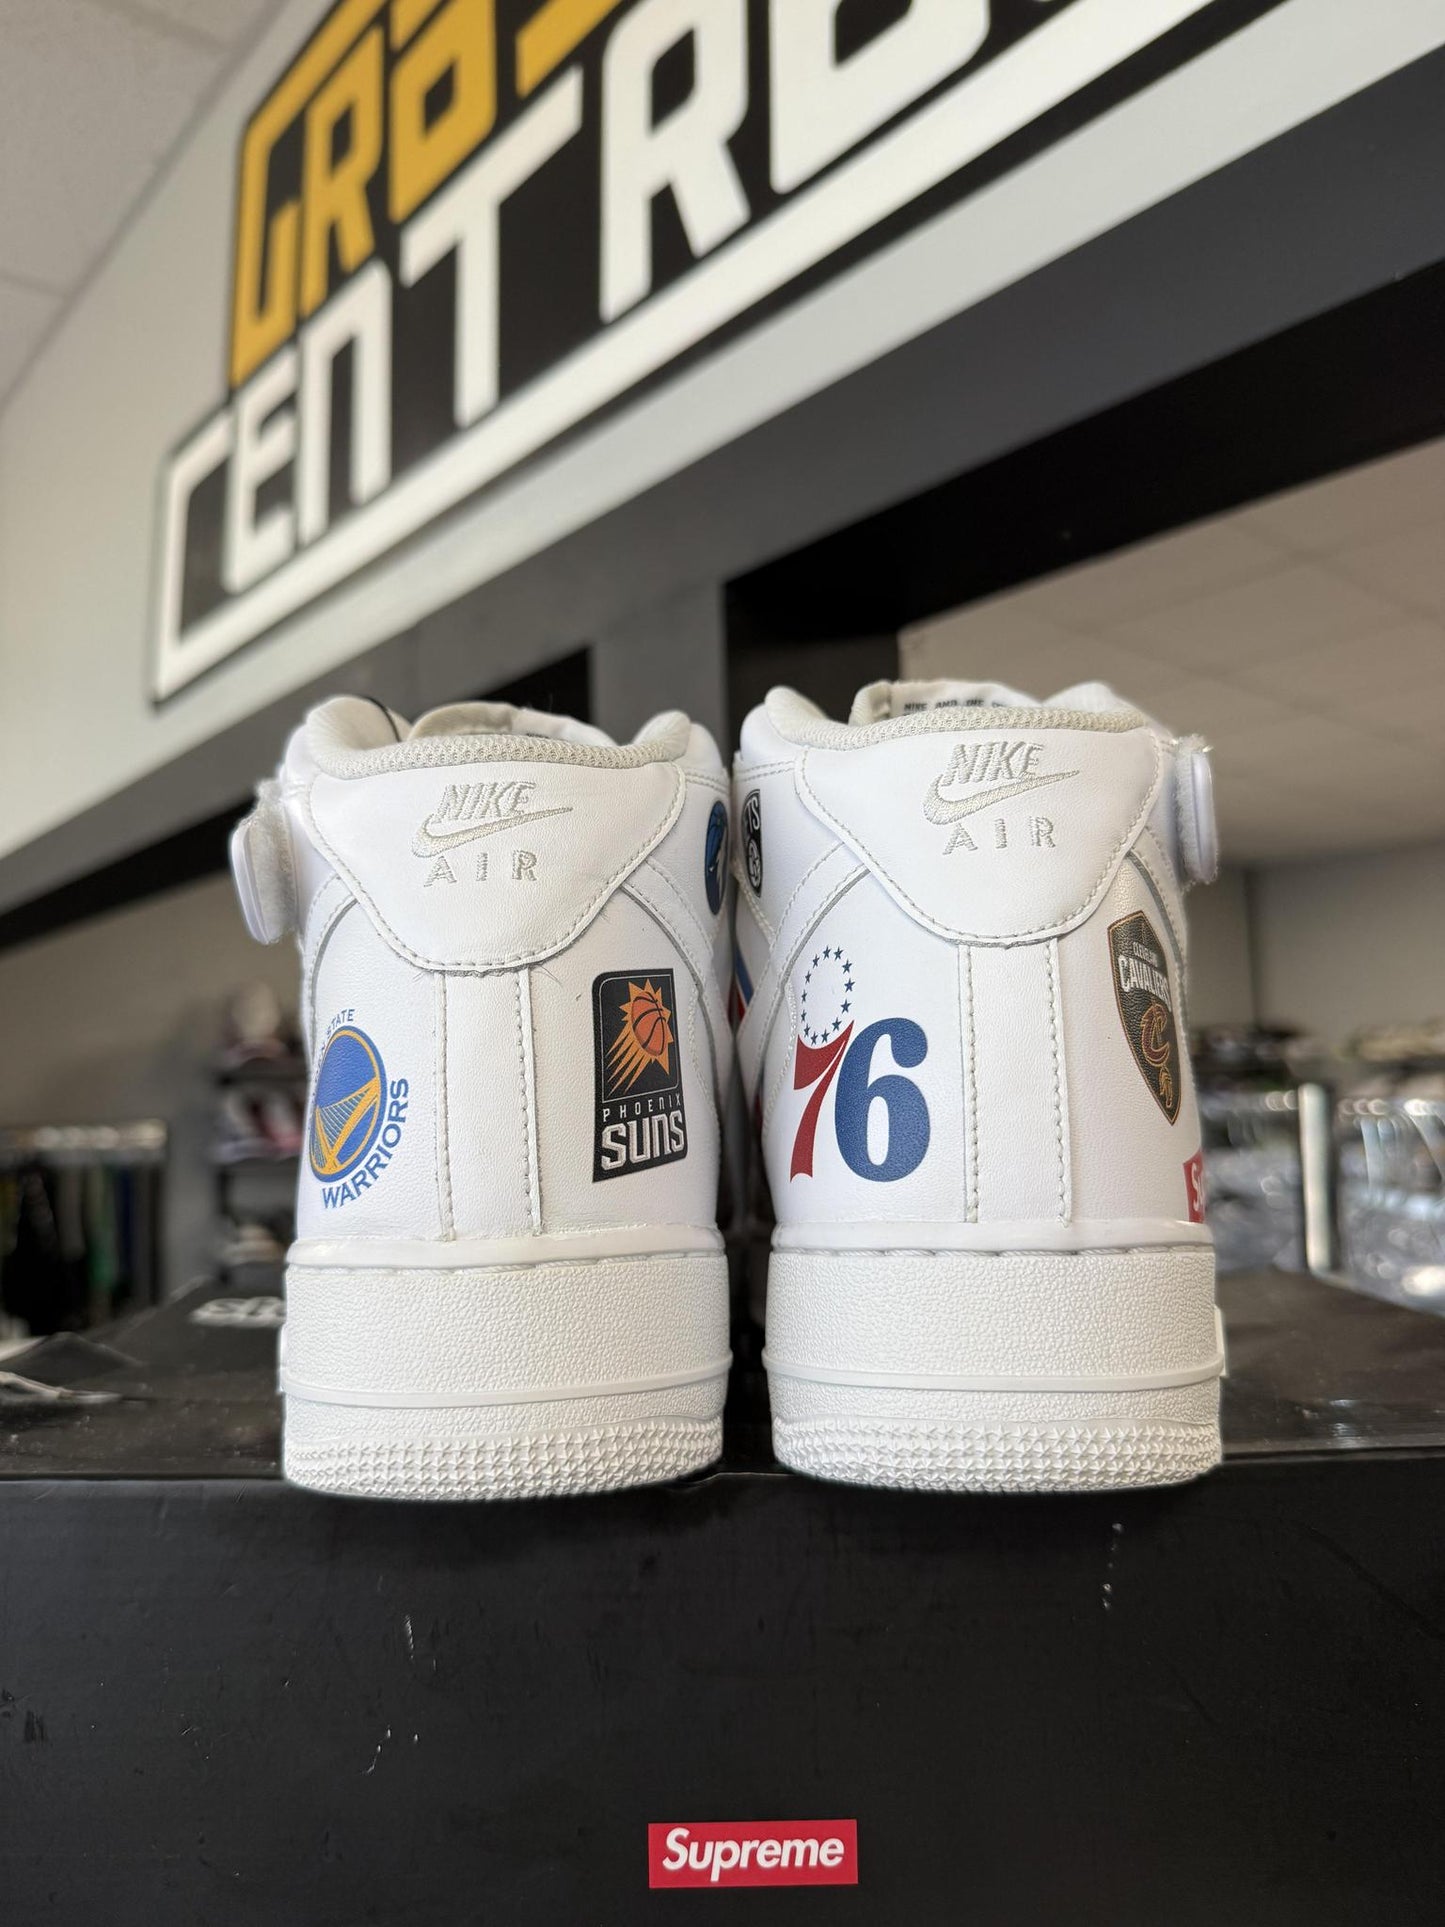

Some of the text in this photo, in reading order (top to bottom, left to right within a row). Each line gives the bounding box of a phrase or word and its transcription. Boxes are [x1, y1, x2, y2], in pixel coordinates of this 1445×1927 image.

[940, 741, 1045, 787] NIKE
[429, 781, 537, 825] NIKE
[941, 815, 1056, 856] AIR
[423, 849, 538, 888] AIR
[326, 1008, 356, 1039] STATE
[603, 1093, 682, 1123] PHOENIX
[789, 1017, 931, 1184] 76
[321, 1077, 410, 1209] WARRIORS
[600, 1109, 686, 1171] SUNS
[661, 1826, 845, 1883] Supreme
